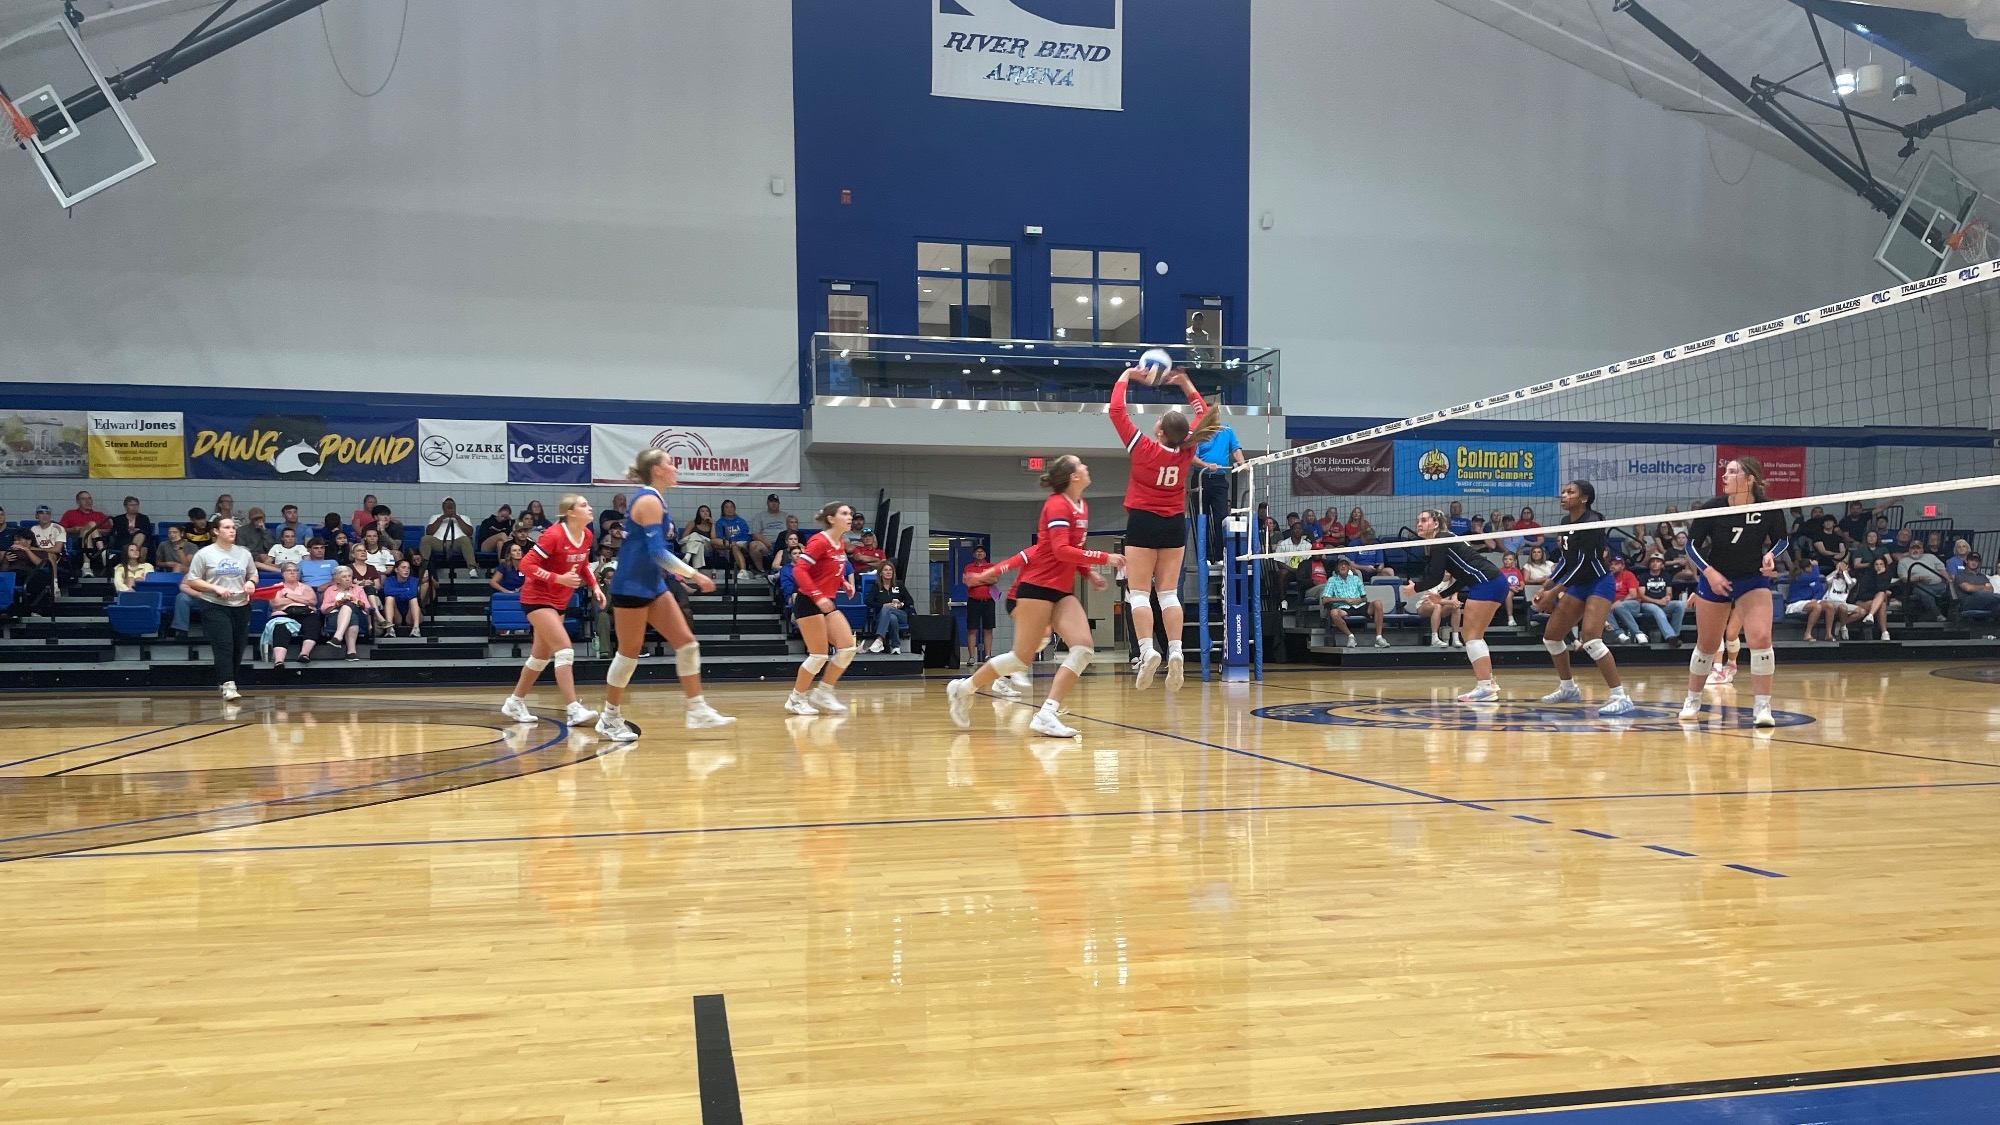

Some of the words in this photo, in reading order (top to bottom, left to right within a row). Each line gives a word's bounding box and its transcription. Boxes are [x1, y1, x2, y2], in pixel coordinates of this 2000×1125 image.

[943, 31, 1029, 58] RIVER
[1034, 40, 1111, 62] BEND
[983, 62, 1074, 86] ARENA
[1626, 354, 1655, 367] TRAILBLAZERS
[1683, 338, 1716, 352] TRAILBLAZERS
[1748, 320, 1784, 335] TRAILBLAZERS
[1819, 299, 1860, 316] TRAILBLAZERS
[1900, 275, 1947, 294] TRAILBLAZERS
[94, 418, 138, 430] Edward
[139, 419, 176, 431] Jones
[104, 440, 128, 448] Steve
[130, 440, 168, 448] Medford
[191, 429, 279, 462] DAWG
[319, 434, 415, 465] POUND
[455, 443, 504, 453] OZARK
[537, 444, 589, 454] EXERCISE
[471, 453, 490, 461] Firm,
[509, 443, 535, 463] LC
[537, 454, 585, 465] SCIENCE
[1456, 446, 1534, 469] Colman's
[688, 457, 749, 471] WEGMAN
[1313, 457, 1326, 465] OSF
[1628, 459, 1706, 474] Healthcare
[1155, 466, 1180, 486] 18
[1457, 469, 1492, 480] Country
[1494, 469, 1534, 480] Campers
[1568, 459, 1619, 481] HRN
[1745, 512, 1762, 524] LC
[1731, 527, 1744, 543] 7
